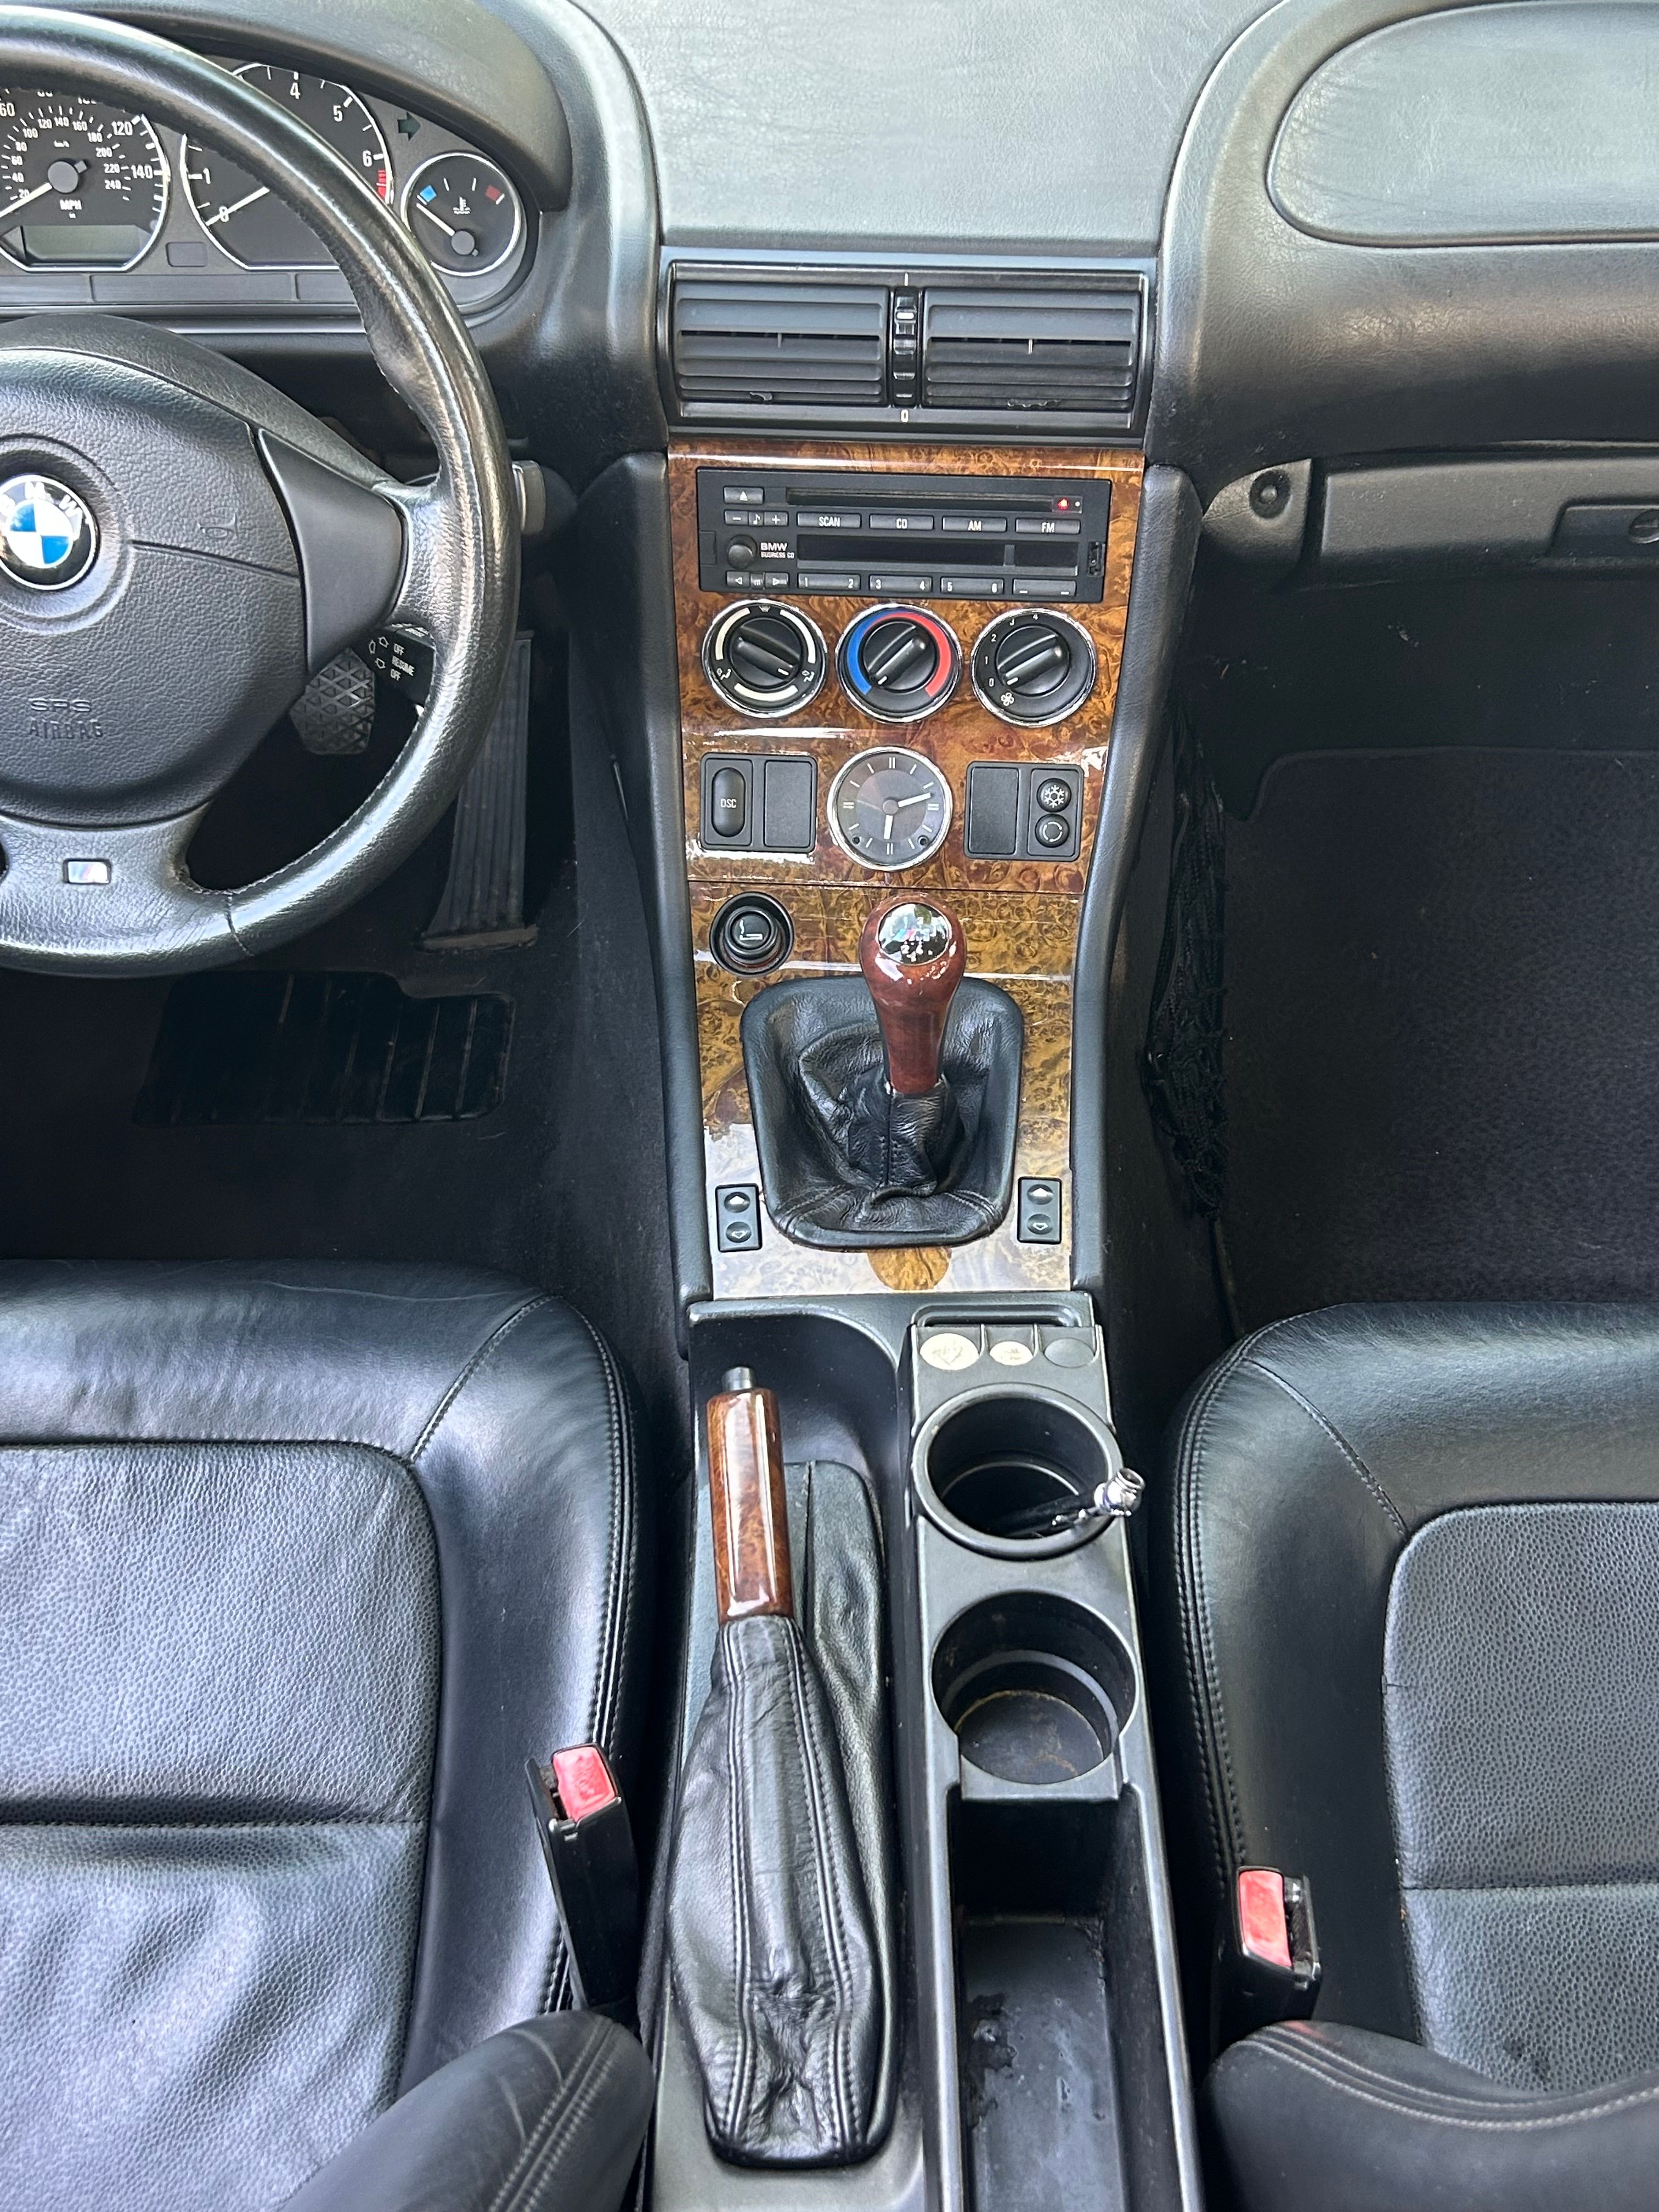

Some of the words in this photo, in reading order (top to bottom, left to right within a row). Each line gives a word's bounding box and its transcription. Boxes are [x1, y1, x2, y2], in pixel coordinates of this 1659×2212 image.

[290, 82, 301, 99] 4
[0, 103, 15, 116] 60
[333, 105, 343, 122] 5
[38, 119, 52, 129] 120
[54, 117, 69, 127] 140
[72, 121, 88, 131] 160
[22, 128, 38, 138] 100
[111, 121, 133, 136] 120
[96, 148, 112, 157] 200
[363, 150, 373, 167] 6
[104, 163, 120, 173] 220
[131, 165, 153, 179] 140
[12, 172, 24, 183] 40
[203, 168, 211, 184] 1
[105, 180, 121, 190] 240
[59, 200, 82, 210] MPH
[819, 516, 840, 527] SCAN
[896, 518, 907, 529] CD
[968, 521, 981, 531] AM
[1042, 522, 1055, 533] FM
[760, 542, 787, 551] BMW
[805, 577, 808, 588] 1
[848, 579, 854, 588] 2
[876, 579, 881, 589] 3
[919, 581, 926, 590] 4
[947, 582, 952, 592] 5
[991, 583, 997, 593] 6
[991, 634, 997, 642] 2
[985, 656, 988, 664] 1
[989, 678, 994, 687] 0
[30, 718, 103, 739] AIRBAG
[720, 798, 737, 808] DSC
